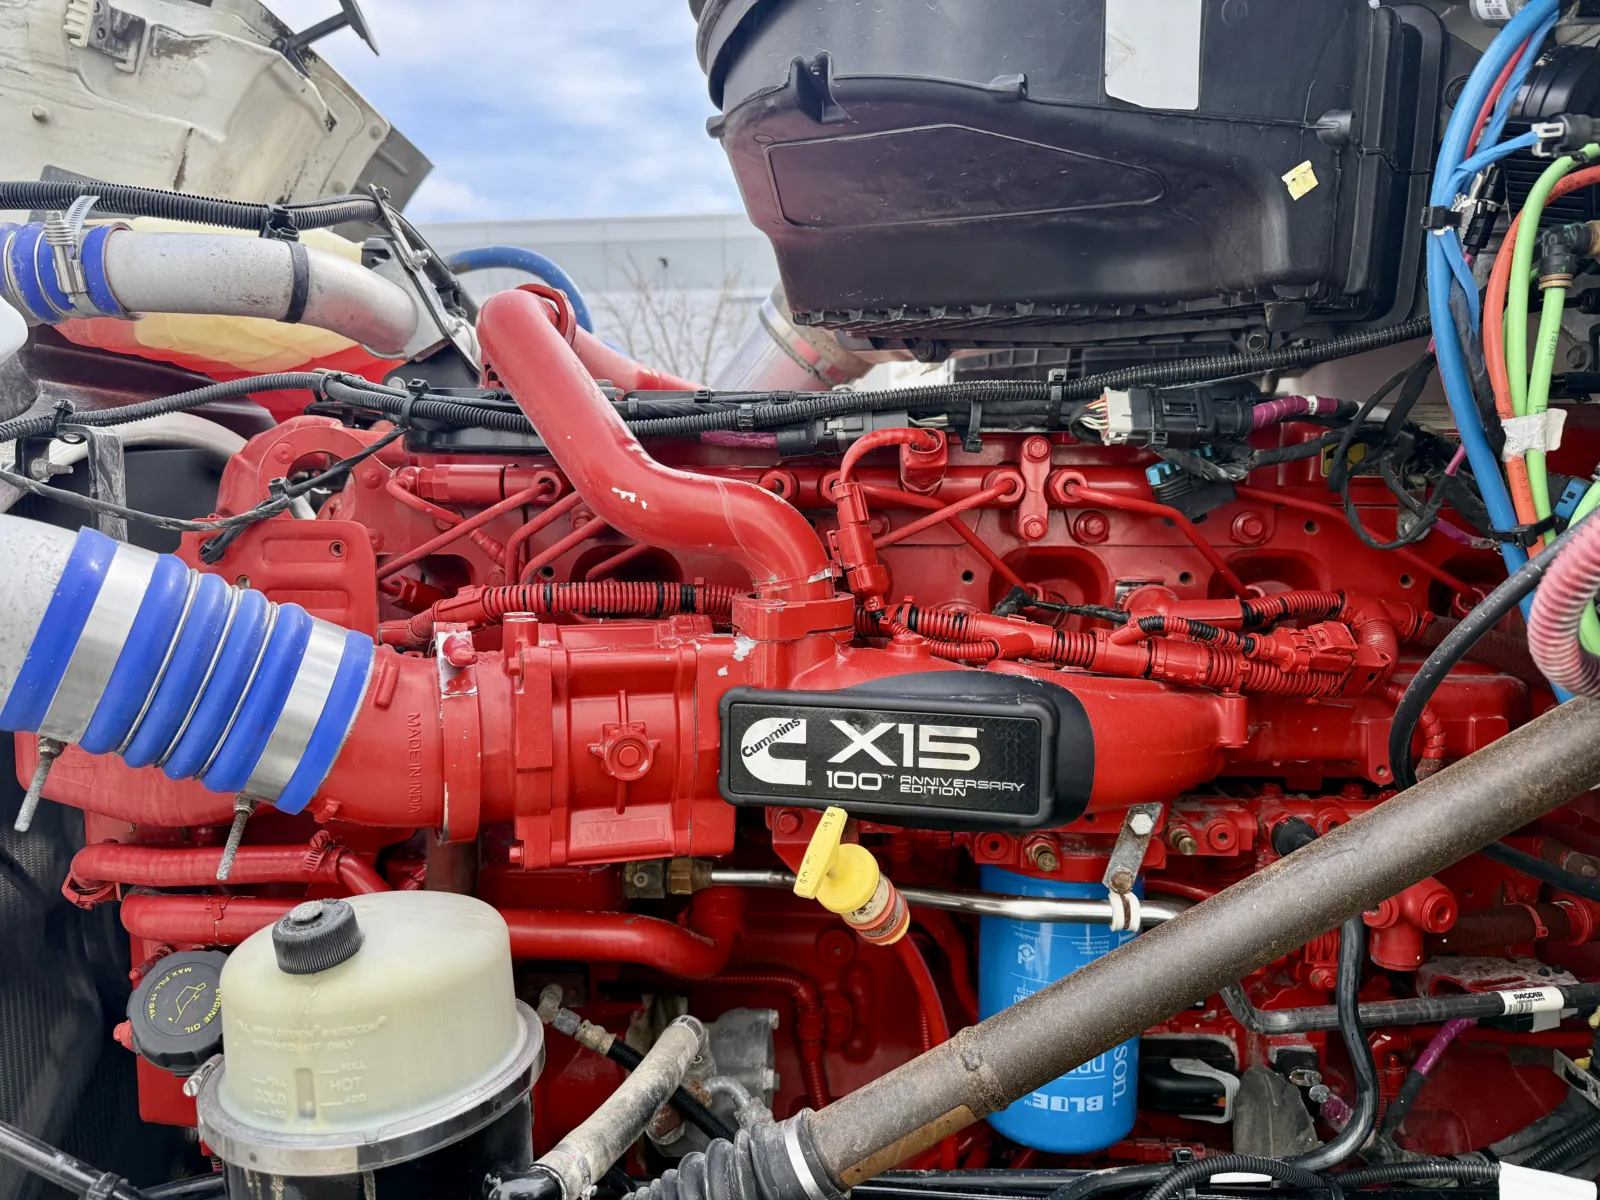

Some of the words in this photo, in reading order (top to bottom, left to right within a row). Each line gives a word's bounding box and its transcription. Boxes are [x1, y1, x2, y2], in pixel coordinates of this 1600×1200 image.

[408, 712, 421, 761] MADE
[741, 717, 801, 758] Cummins
[409, 764, 422, 776] IN
[900, 775, 1026, 792] ANNIVERSARY
[900, 784, 967, 797] EDITION
[408, 782, 422, 813] INDIA
[171, 967, 192, 977] MAX
[155, 976, 170, 990] FILL
[1513, 991, 1544, 1000] PACCAR
[149, 1003, 157, 1020] GAL
[203, 988, 221, 1024] ENGINE
[185, 1023, 201, 1033] OIL
[326, 1038, 356, 1050] ONLY
[329, 1076, 363, 1092] HOT
[255, 1088, 287, 1105] COLD
